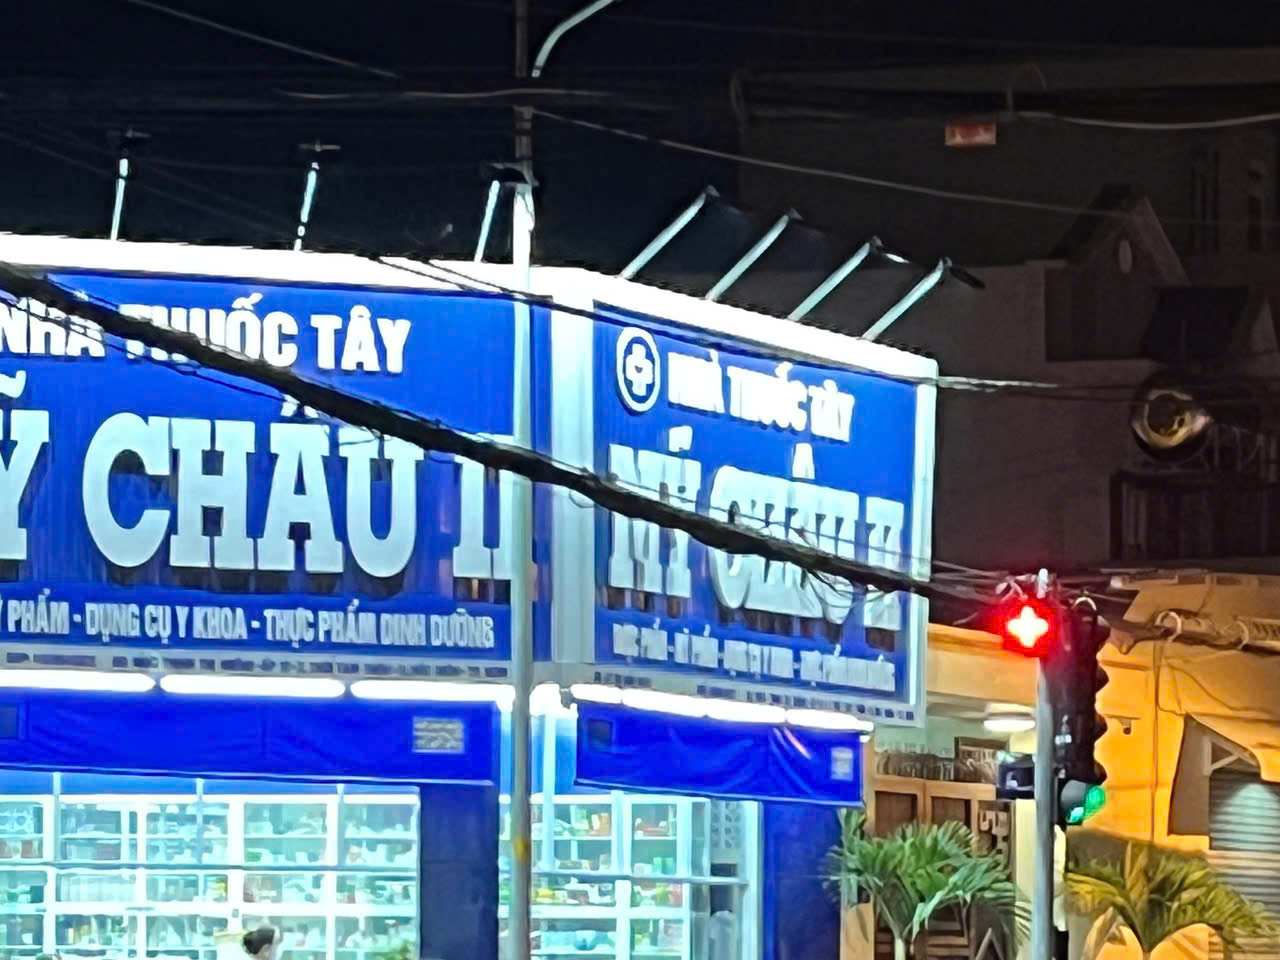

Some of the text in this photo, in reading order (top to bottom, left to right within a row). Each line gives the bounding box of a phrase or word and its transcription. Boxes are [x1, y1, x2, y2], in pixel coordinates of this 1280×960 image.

[310, 304, 412, 373] TÂY
[83, 395, 424, 579] CHÂU
[175, 606, 190, 638] Y
[193, 606, 248, 640] KHOA
